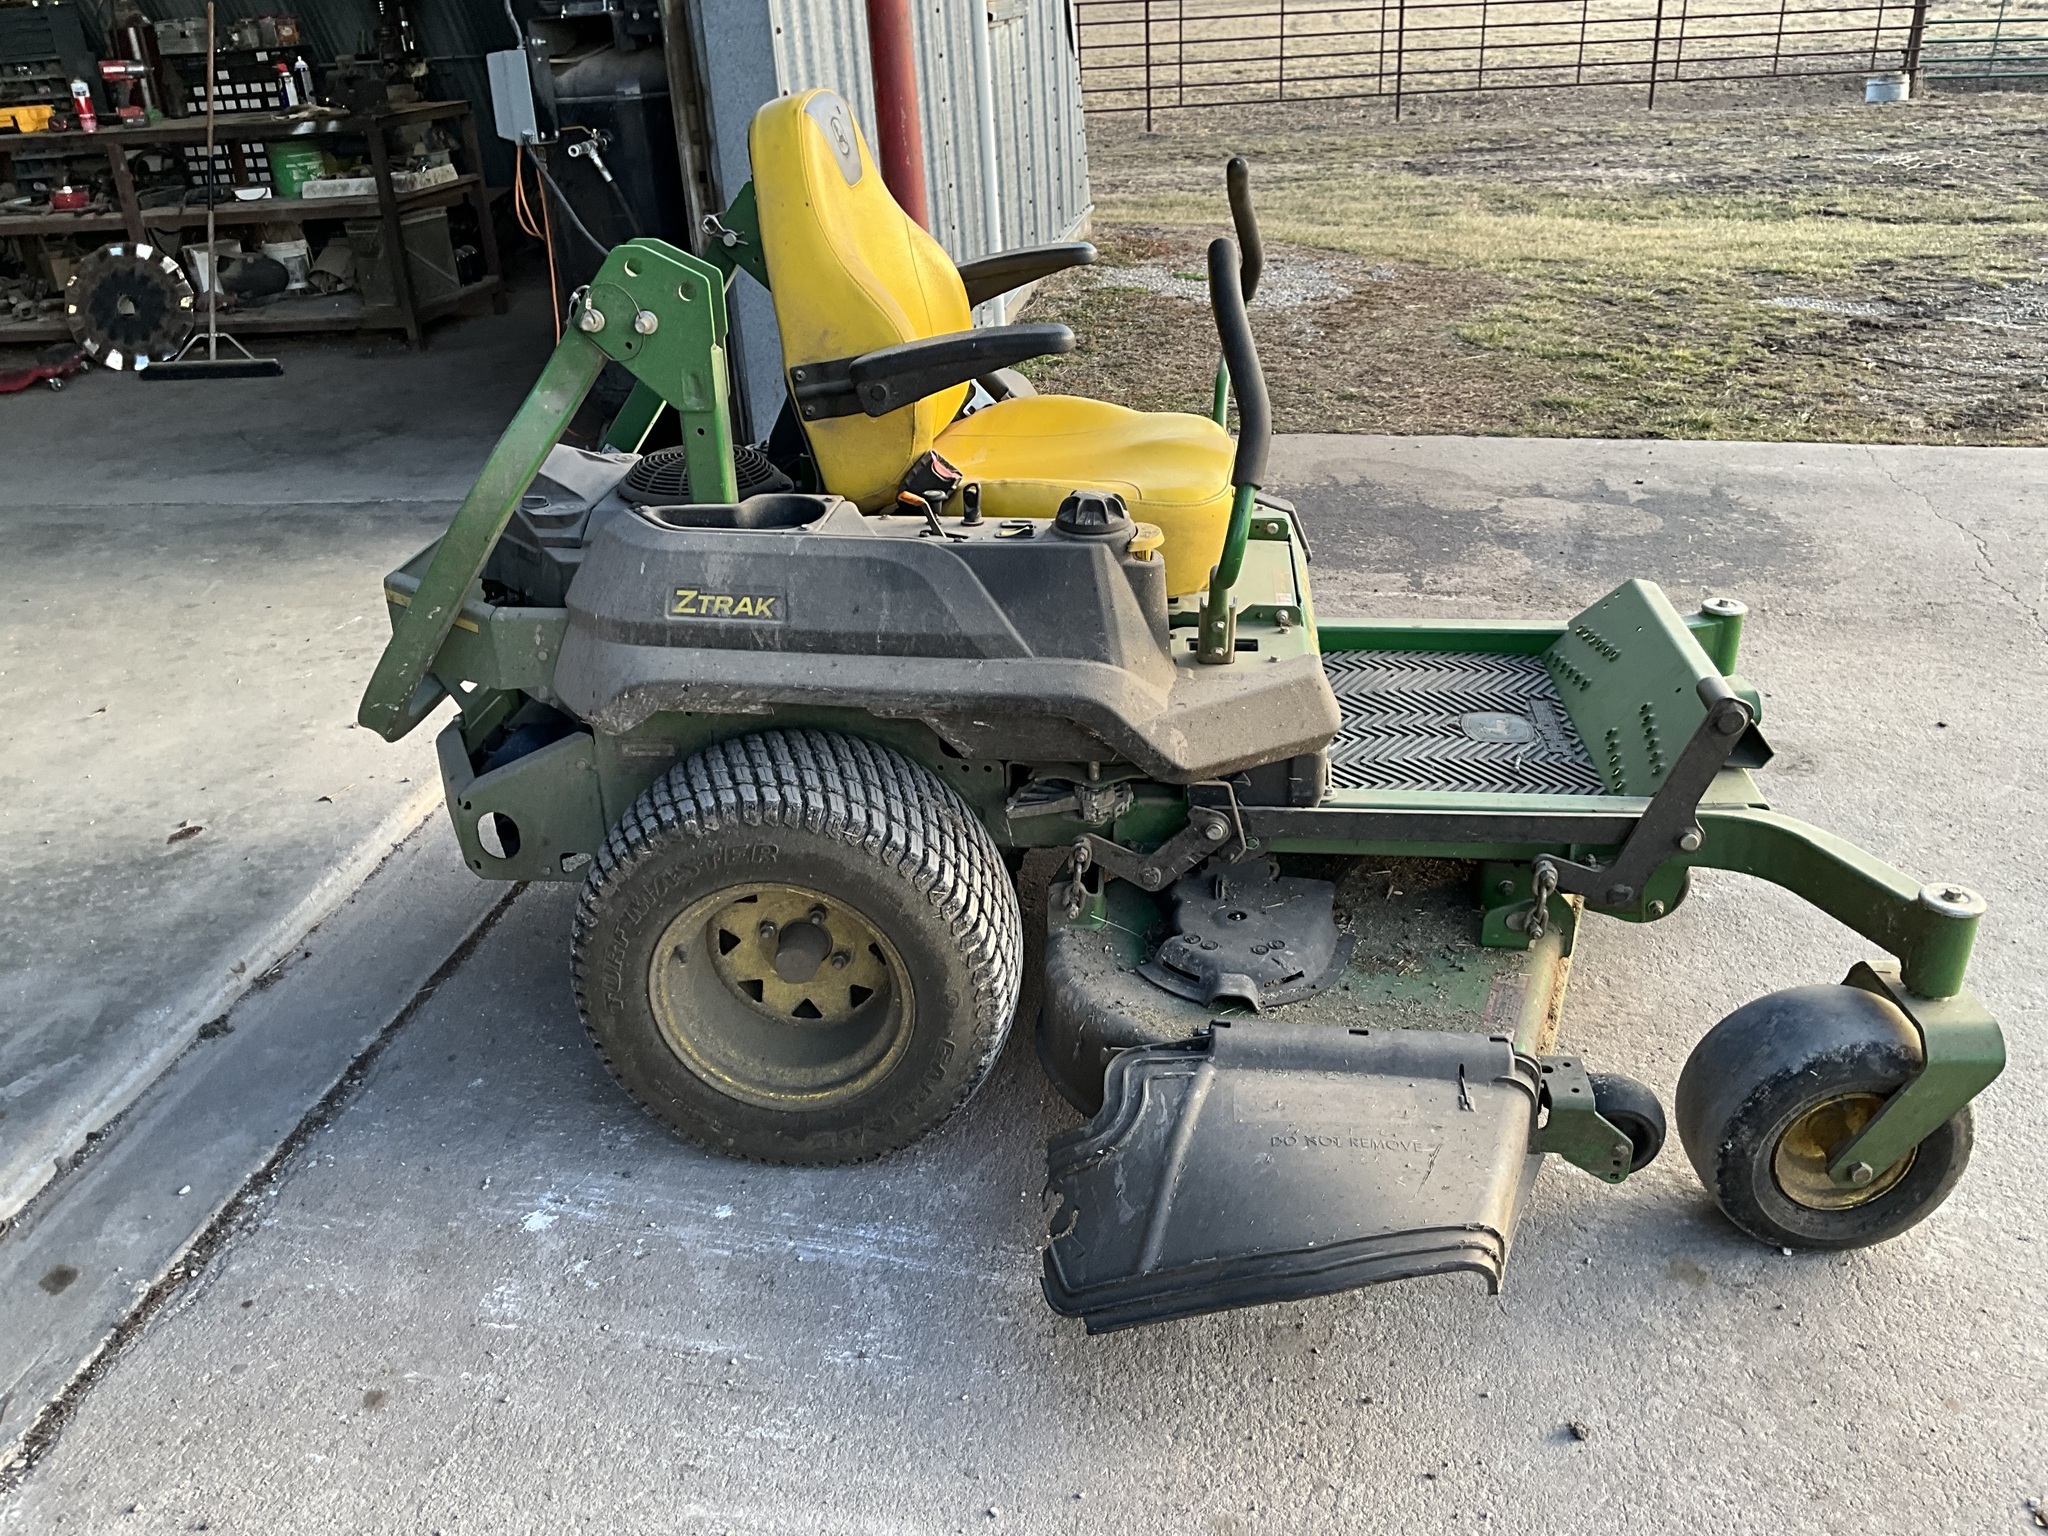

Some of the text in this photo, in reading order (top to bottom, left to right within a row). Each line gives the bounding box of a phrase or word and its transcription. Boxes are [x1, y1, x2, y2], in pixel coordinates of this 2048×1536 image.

[672, 590, 776, 617] ZTRAK
[600, 843, 779, 1016] TURF MASTER
[1269, 1135, 1423, 1152] DO NOT REMOVE
